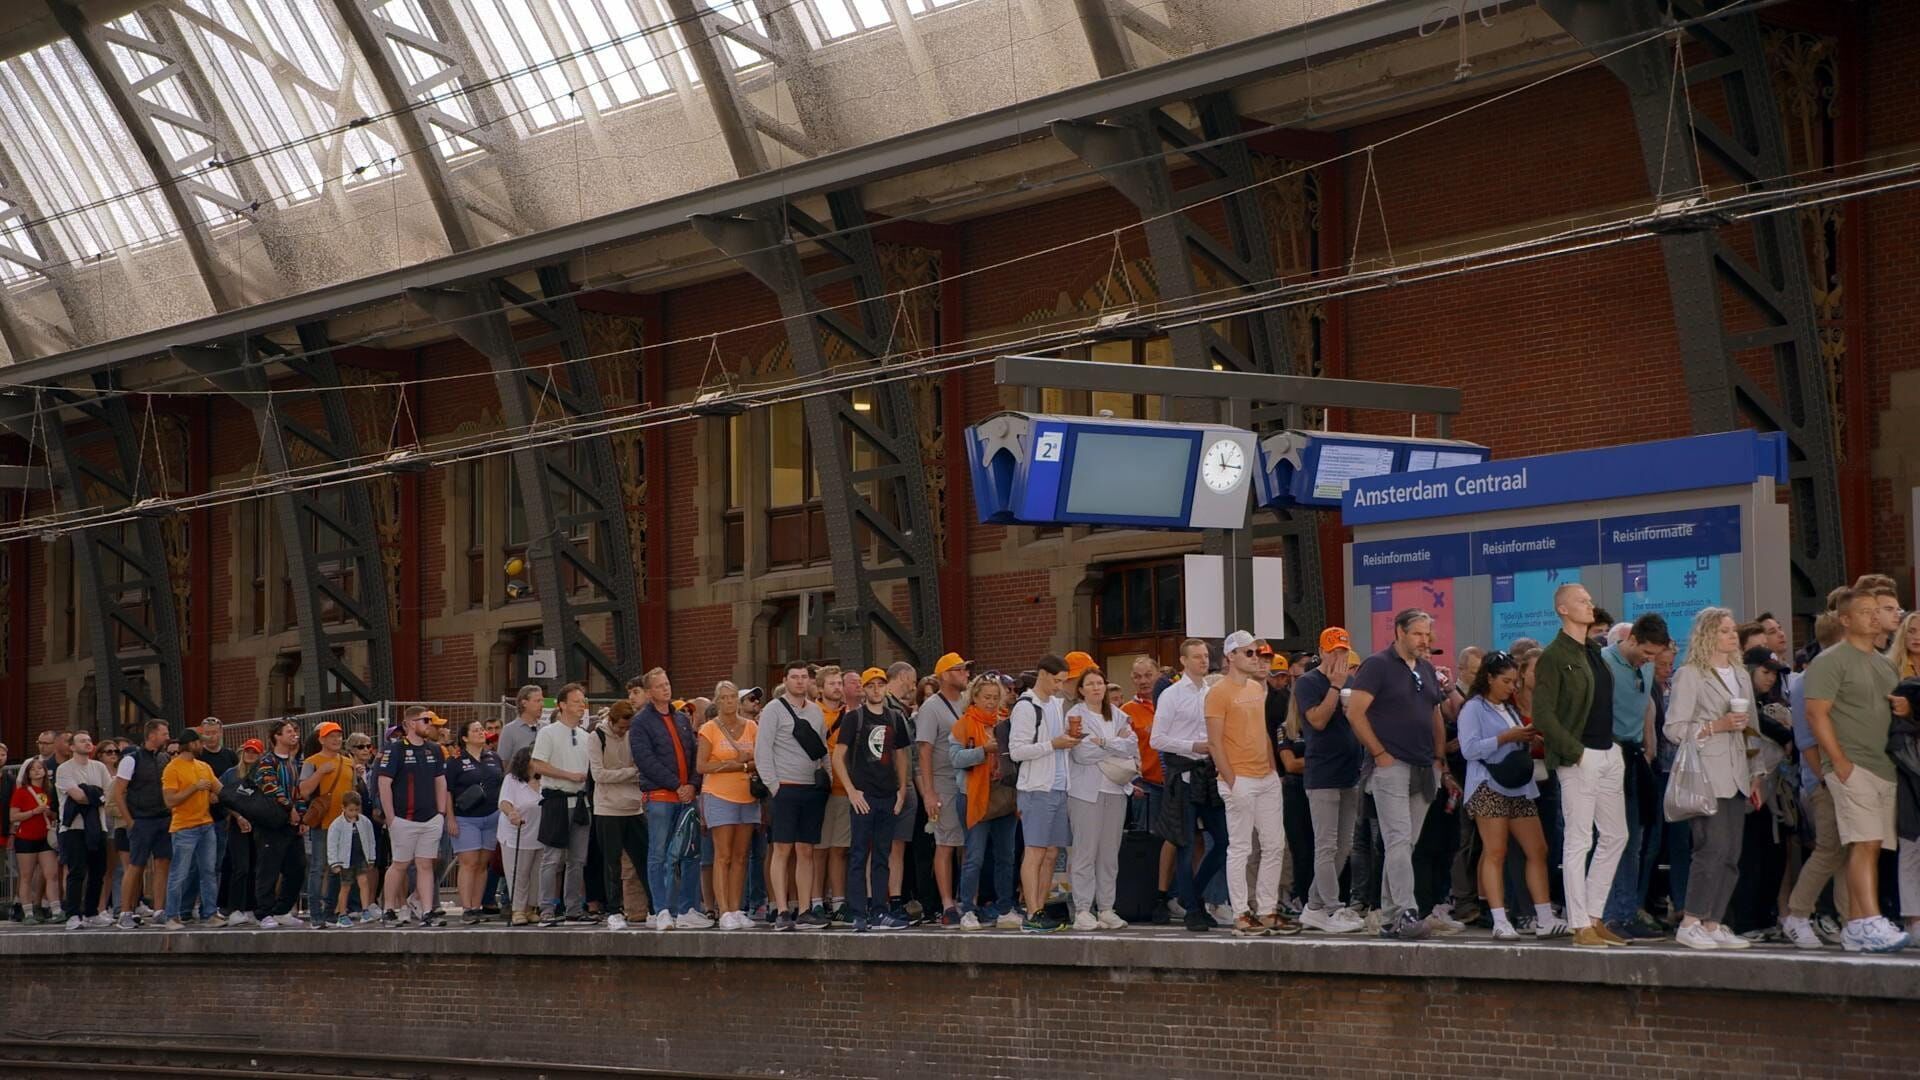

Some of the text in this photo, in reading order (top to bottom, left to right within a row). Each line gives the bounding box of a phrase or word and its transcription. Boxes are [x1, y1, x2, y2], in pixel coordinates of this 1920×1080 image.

[1354, 479, 1448, 508] Amsterdam
[1455, 467, 1527, 496] Centraal
[1613, 525, 1693, 543] Reisinformatie
[1482, 536, 1556, 555] Reisinformatie
[1363, 549, 1431, 567] Reisinformatie
[1665, 599, 1704, 609] information
[534, 660, 546, 675] D
